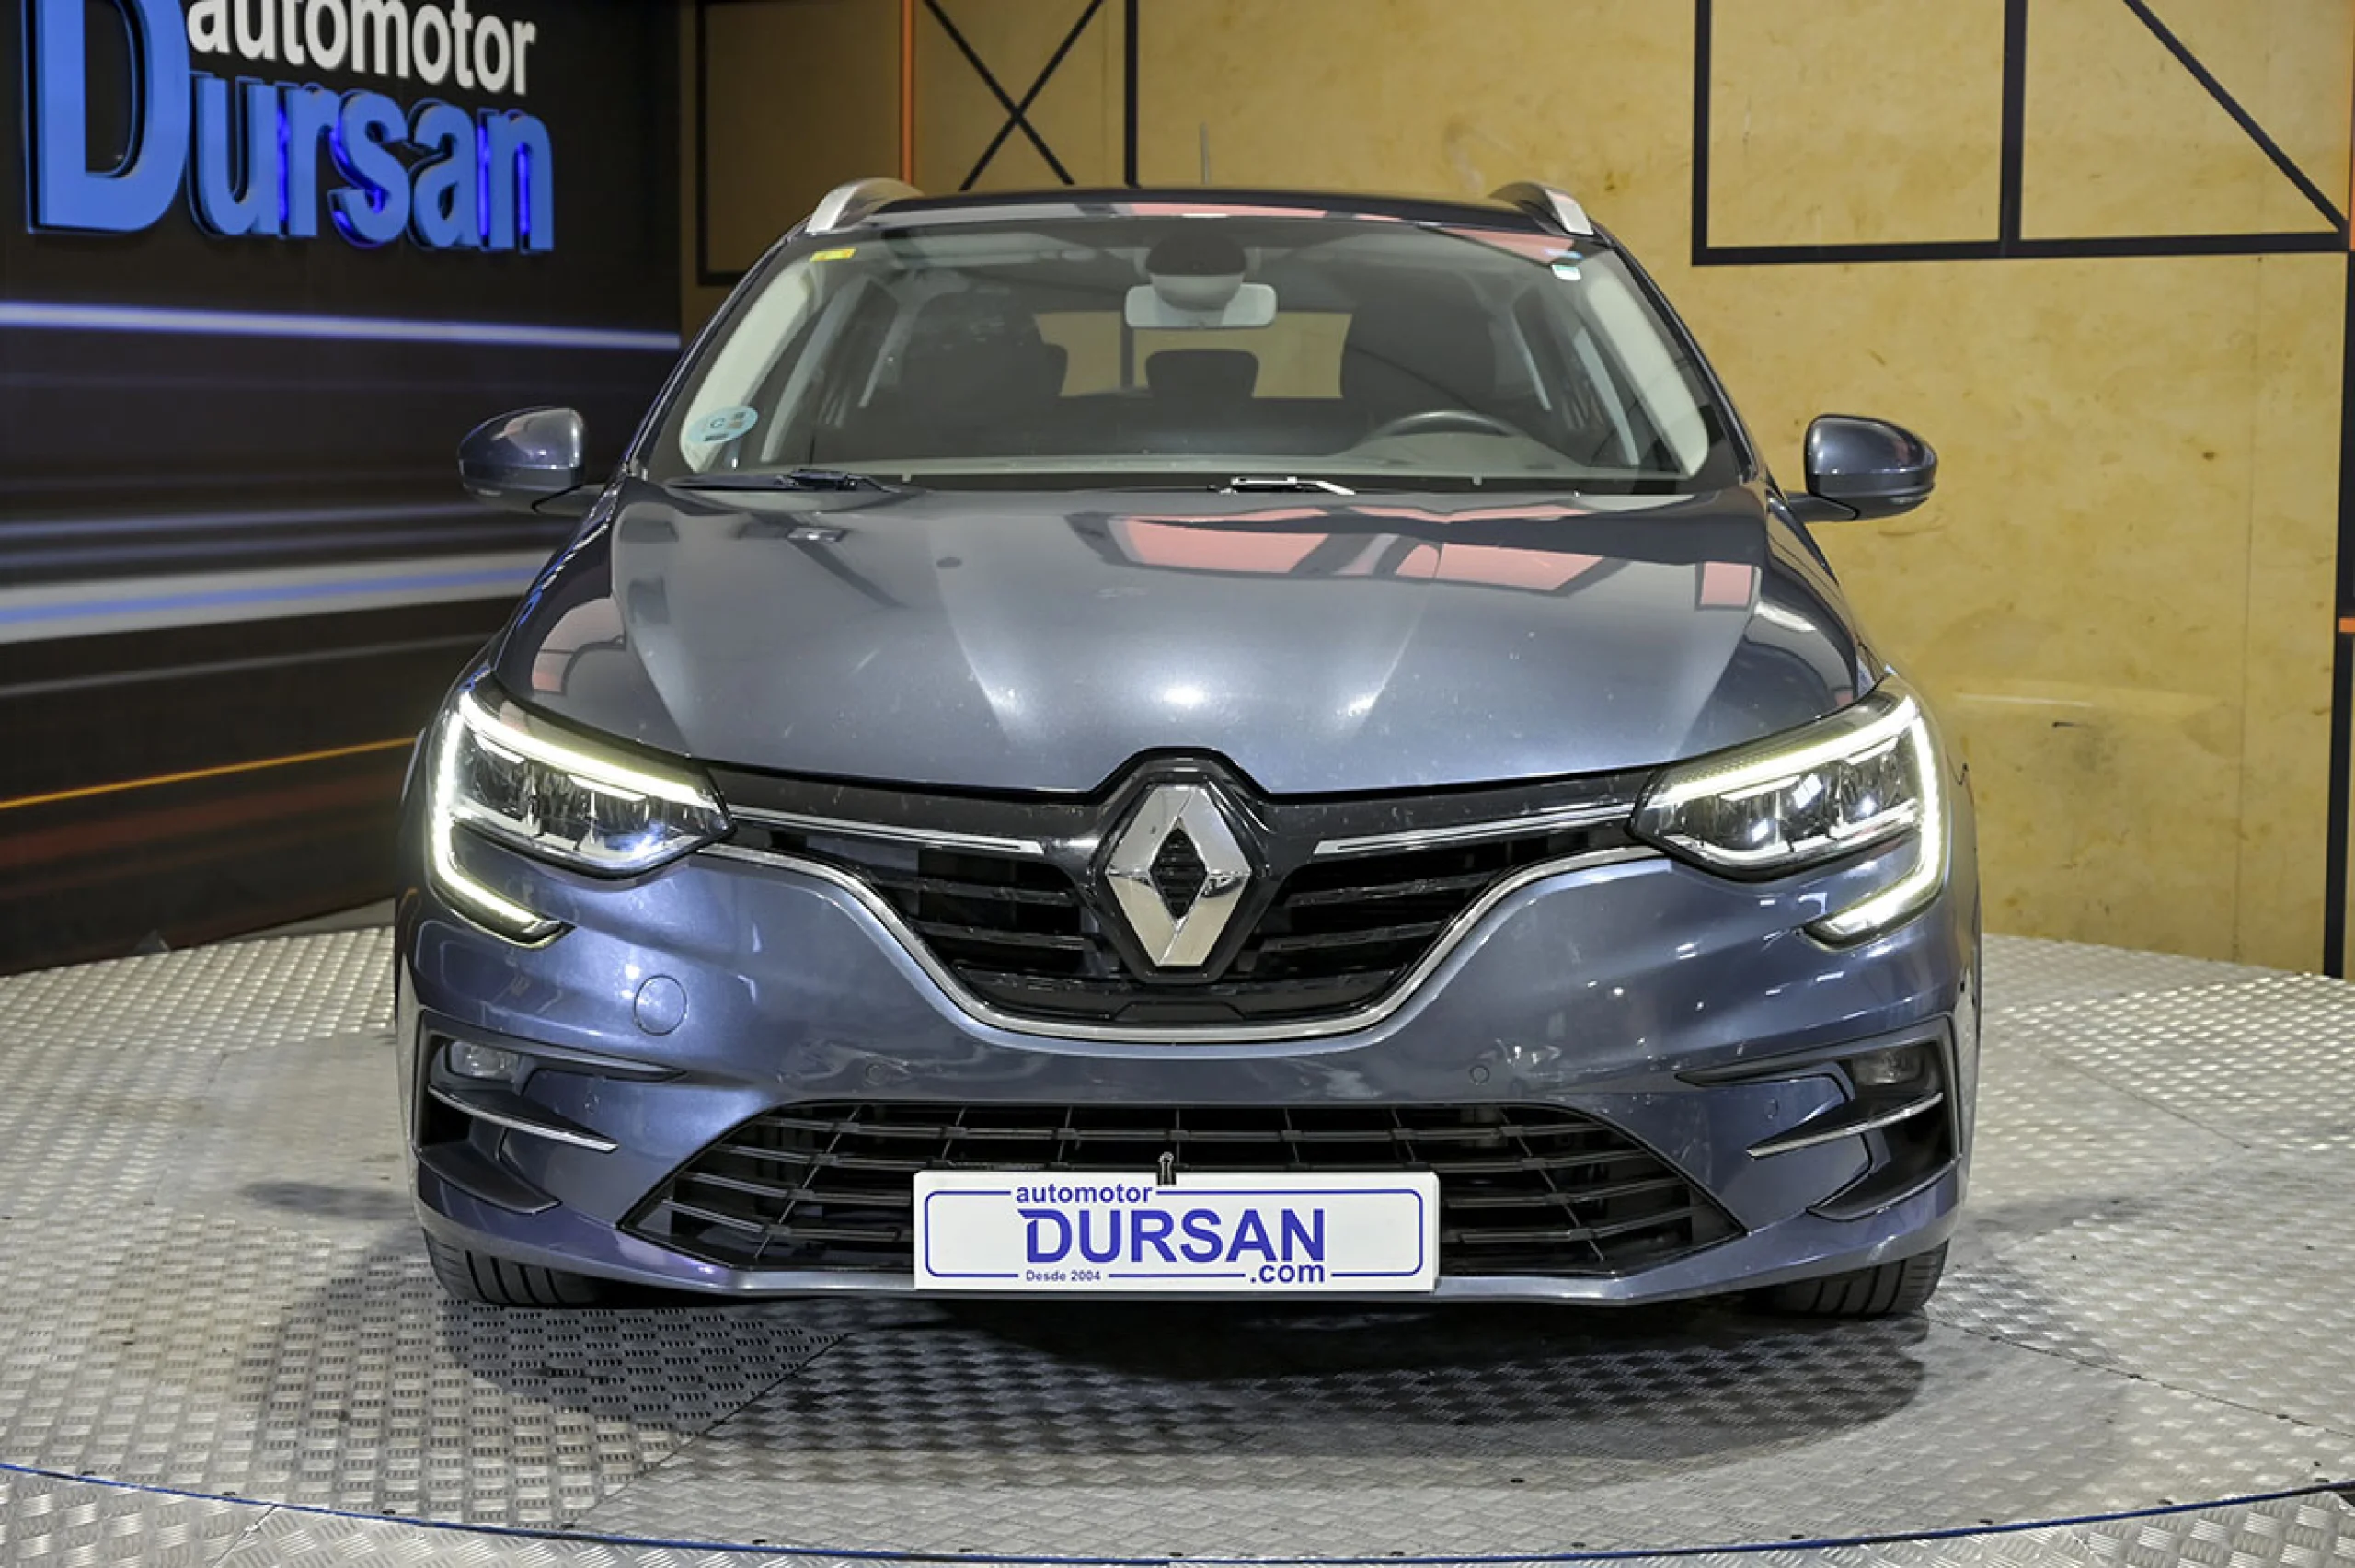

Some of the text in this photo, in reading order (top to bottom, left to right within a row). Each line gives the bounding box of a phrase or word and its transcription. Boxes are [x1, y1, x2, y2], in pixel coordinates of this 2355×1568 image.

[187, 0, 535, 95] automotor
[25, 0, 554, 253] Dursan
[1016, 1184, 1153, 1204] automotor
[1017, 1208, 1324, 1263] DURSAN
[1026, 1270, 1101, 1282] Desde 2004
[1250, 1264, 1325, 1284] .com
